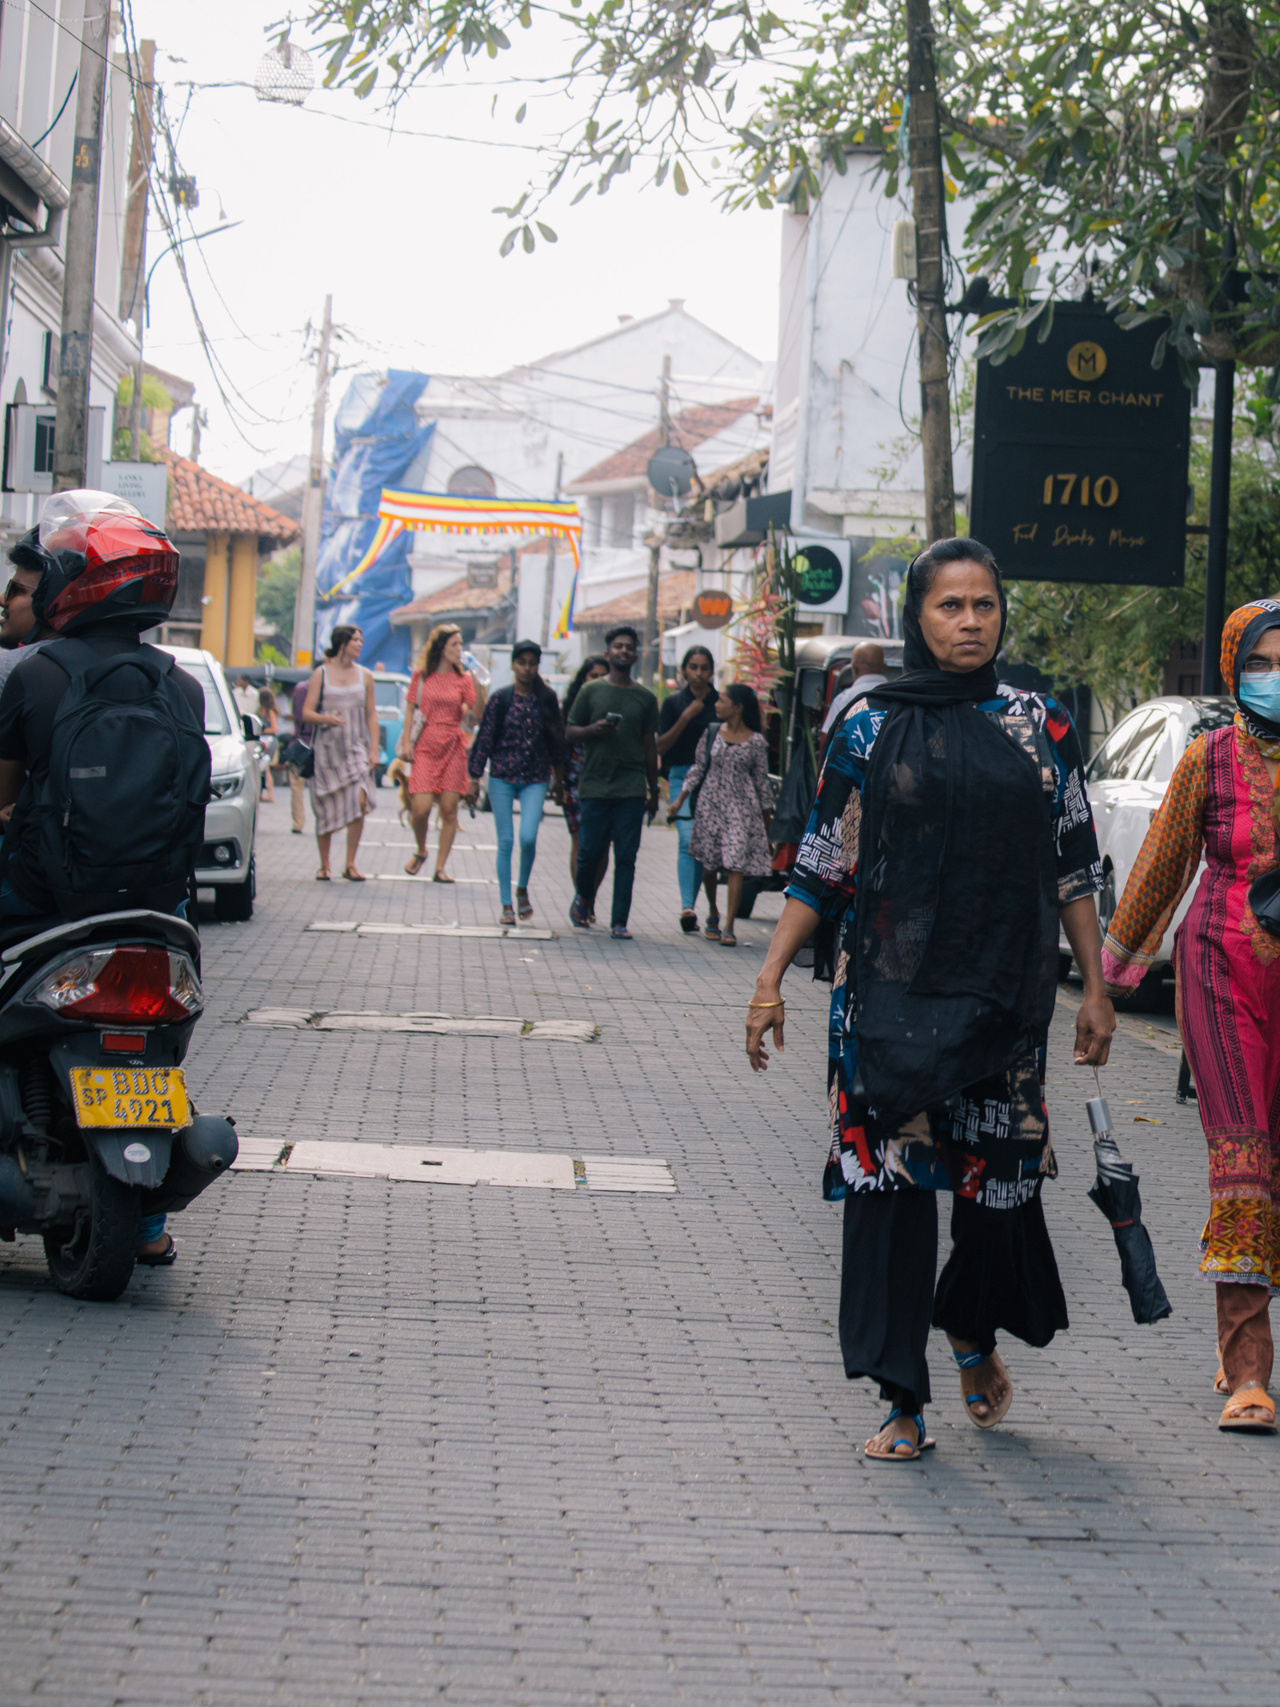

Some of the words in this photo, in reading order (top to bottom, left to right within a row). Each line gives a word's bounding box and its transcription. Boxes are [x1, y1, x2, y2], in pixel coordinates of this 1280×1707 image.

[1077, 351, 1096, 373] M
[1006, 386, 1044, 402] THE
[1043, 473, 1119, 507] 1710
[112, 1071, 168, 1095] BDO
[81, 1087, 107, 1106] SP
[113, 1098, 176, 1123] 4921
